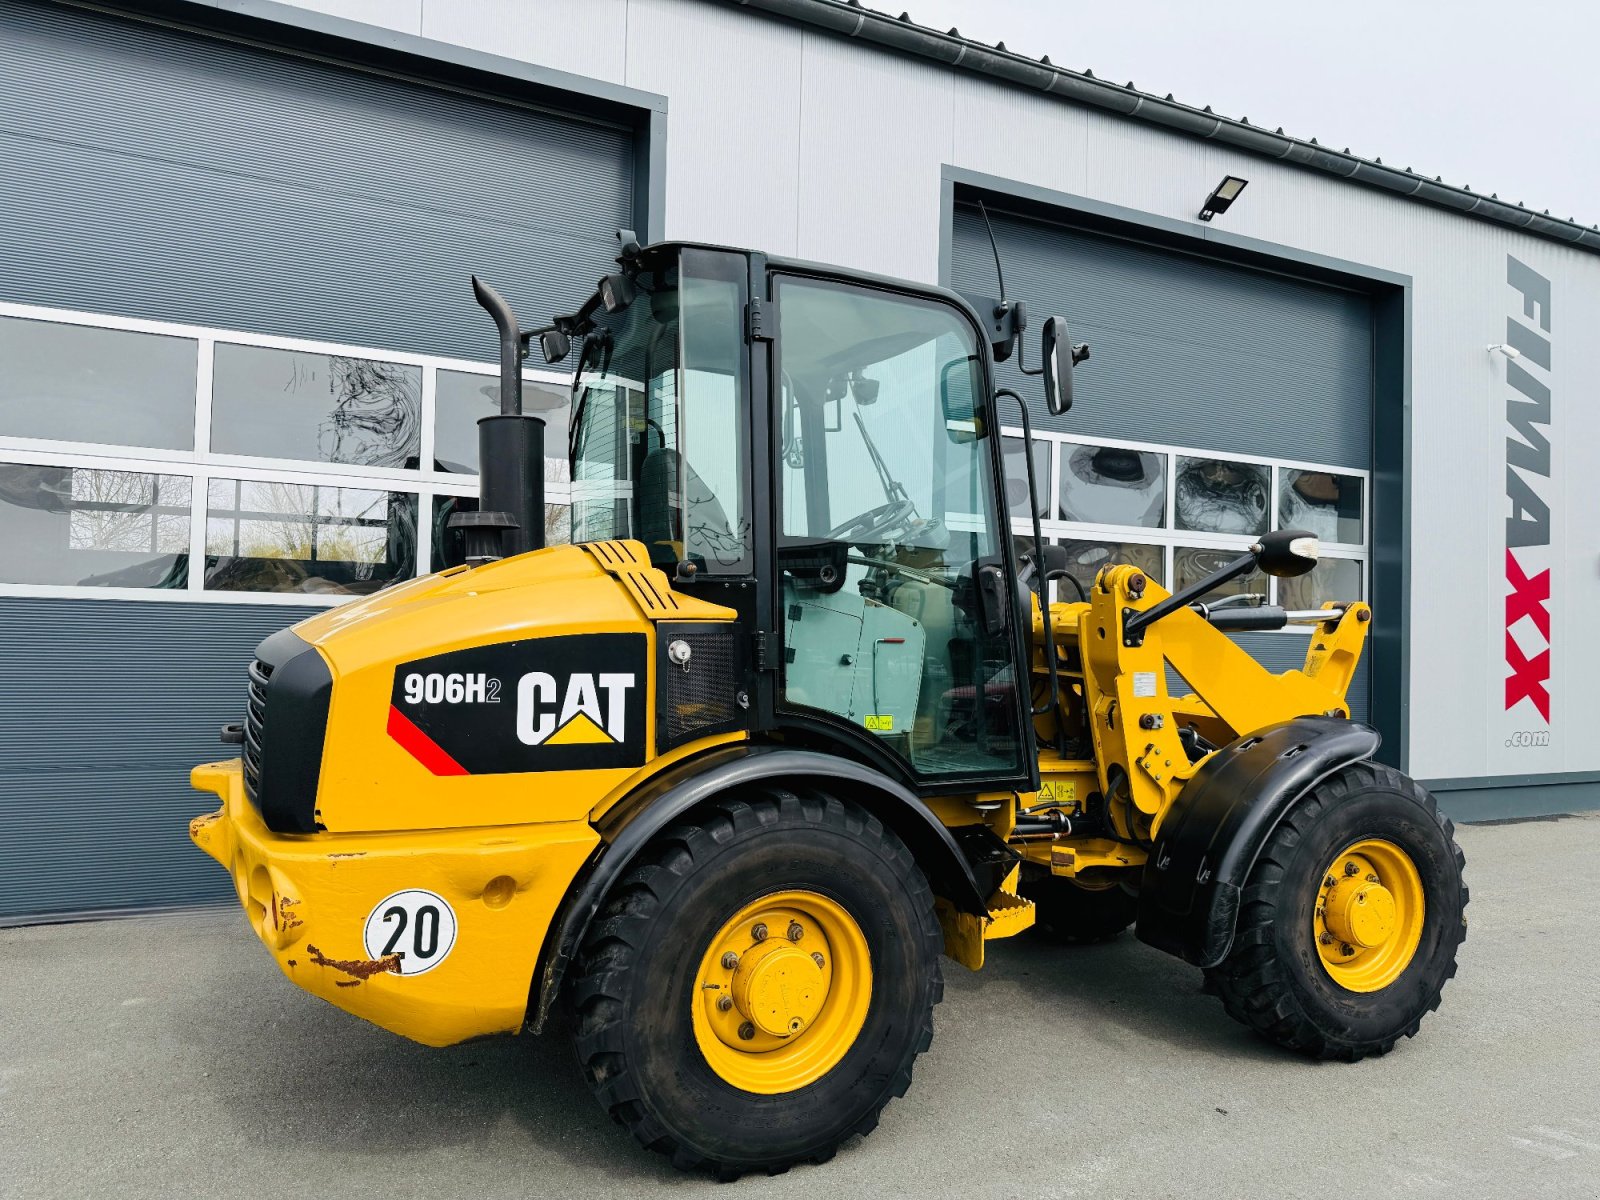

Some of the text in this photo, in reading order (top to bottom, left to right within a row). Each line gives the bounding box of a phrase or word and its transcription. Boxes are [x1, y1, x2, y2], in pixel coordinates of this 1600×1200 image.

[1506, 253, 1550, 726] FIMAXX
[516, 671, 635, 746] CAT
[1504, 730, 1550, 747] .com
[381, 905, 440, 959] 20
